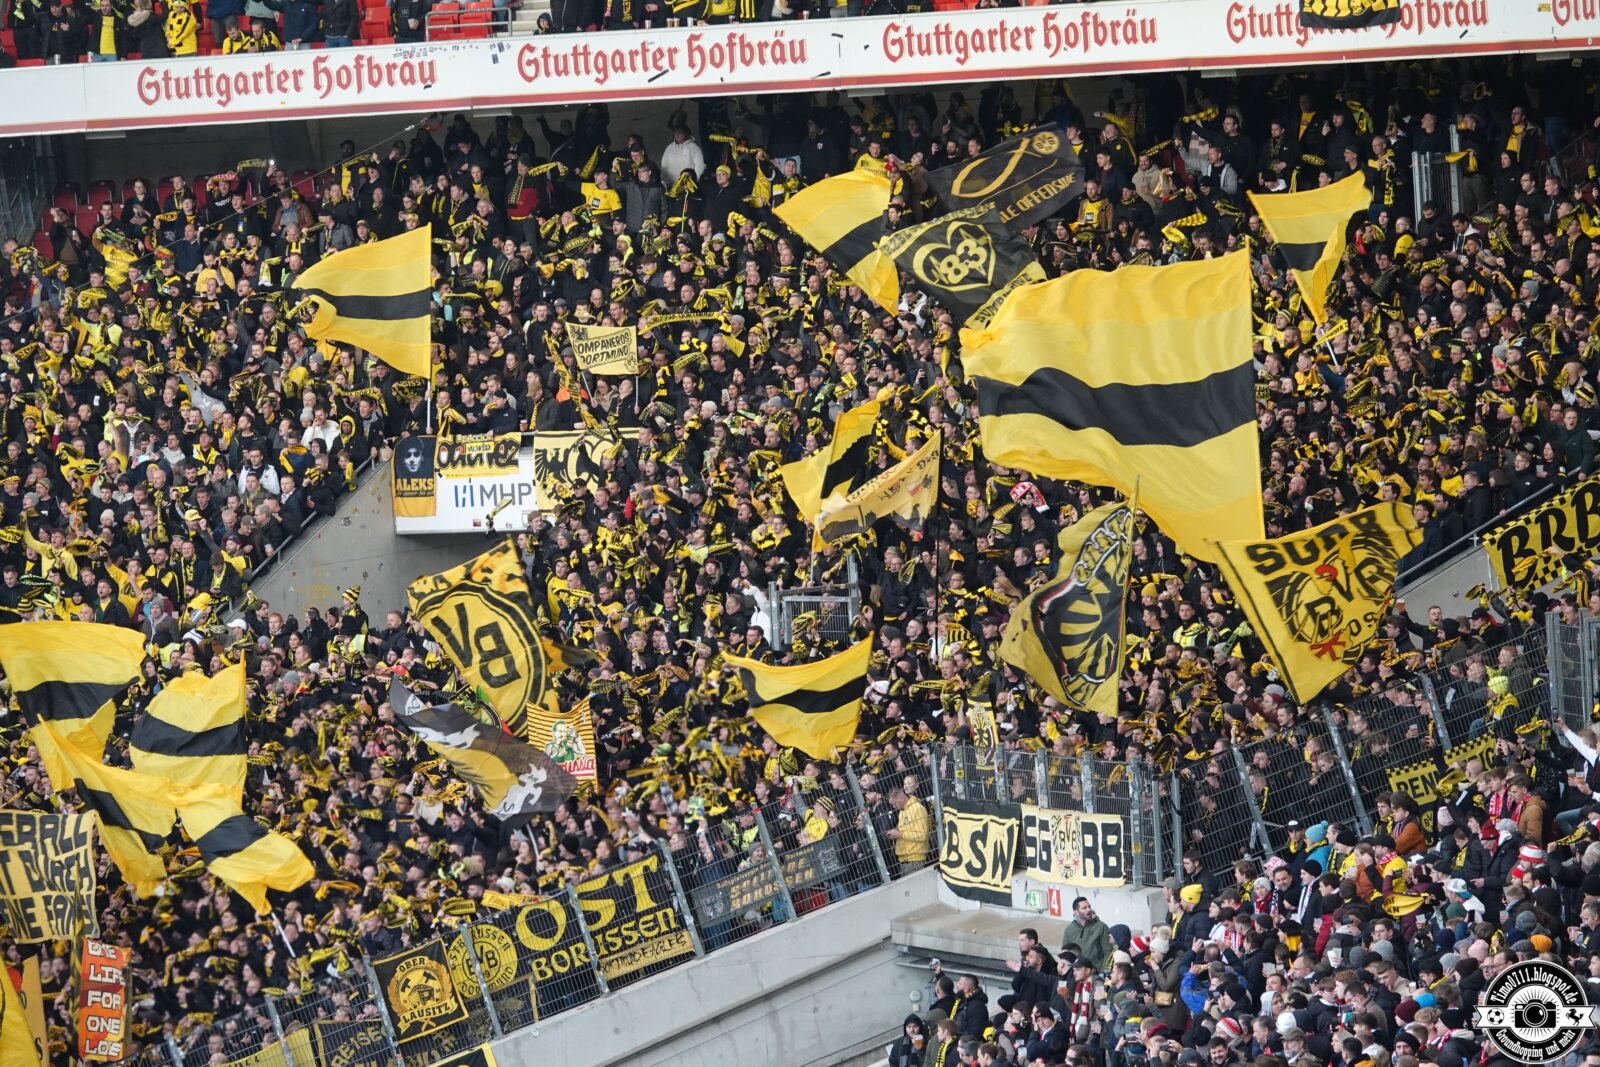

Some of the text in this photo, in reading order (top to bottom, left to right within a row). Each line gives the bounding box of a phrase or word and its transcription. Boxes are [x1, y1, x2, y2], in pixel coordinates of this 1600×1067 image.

[883, 9, 1158, 65] Stuttgarter Hofbräu
[517, 30, 808, 85] Stuttgarter Hofbräu
[137, 53, 437, 107] Stuttgarter Hofbräu
[397, 478, 434, 491] ALEKS
[940, 820, 1014, 883] BSW
[1023, 815, 1051, 873] SG
[1081, 821, 1123, 879] RB
[515, 855, 658, 951] OST
[1051, 889, 1059, 914] 4
[399, 957, 426, 973] OBER
[87, 990, 121, 1009] FOR
[402, 1003, 451, 1023] LAUSITZ
[86, 1017, 120, 1034] ONE
